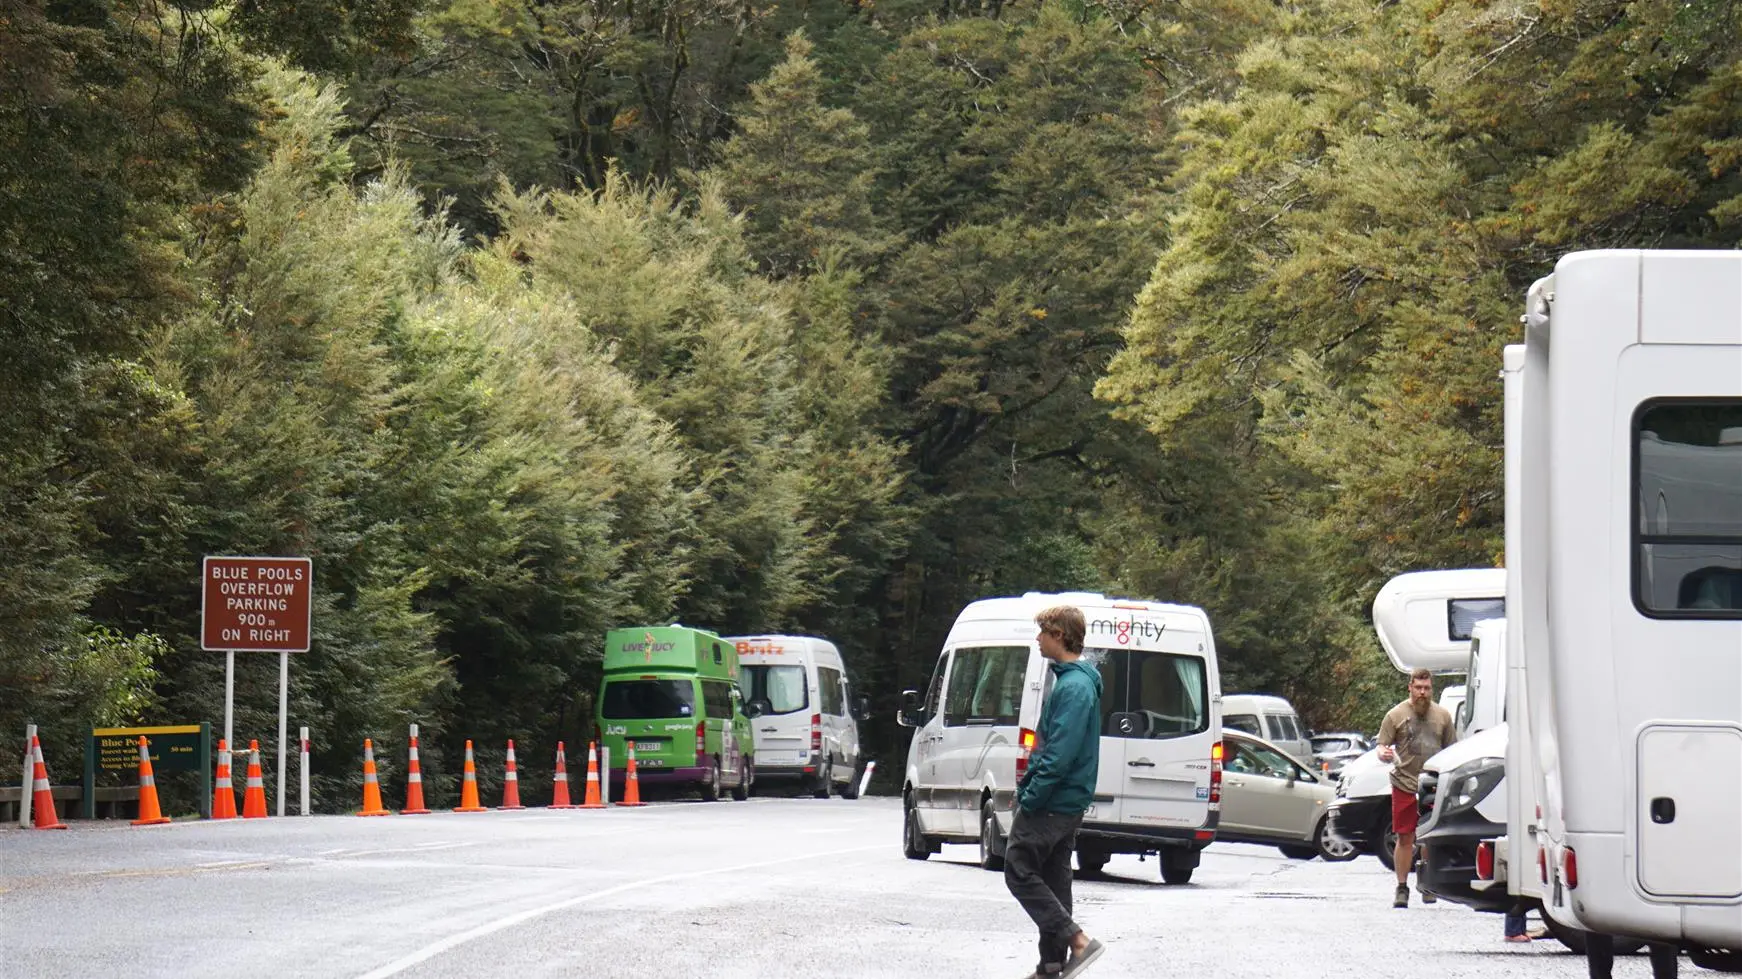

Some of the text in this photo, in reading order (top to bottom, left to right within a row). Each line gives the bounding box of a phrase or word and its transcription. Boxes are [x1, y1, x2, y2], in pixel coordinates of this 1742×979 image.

[212, 567, 303, 580] BLUE POOLS
[220, 582, 294, 595] OVERFLOW
[227, 598, 287, 611] PARKING
[238, 613, 266, 626] 900
[221, 628, 291, 641] ON RIGHT
[1091, 614, 1166, 645] mighty
[622, 642, 676, 652] LIVE JUCY
[736, 641, 784, 655] Britz
[606, 724, 627, 735] jucy
[101, 738, 152, 747] Blue Pos
